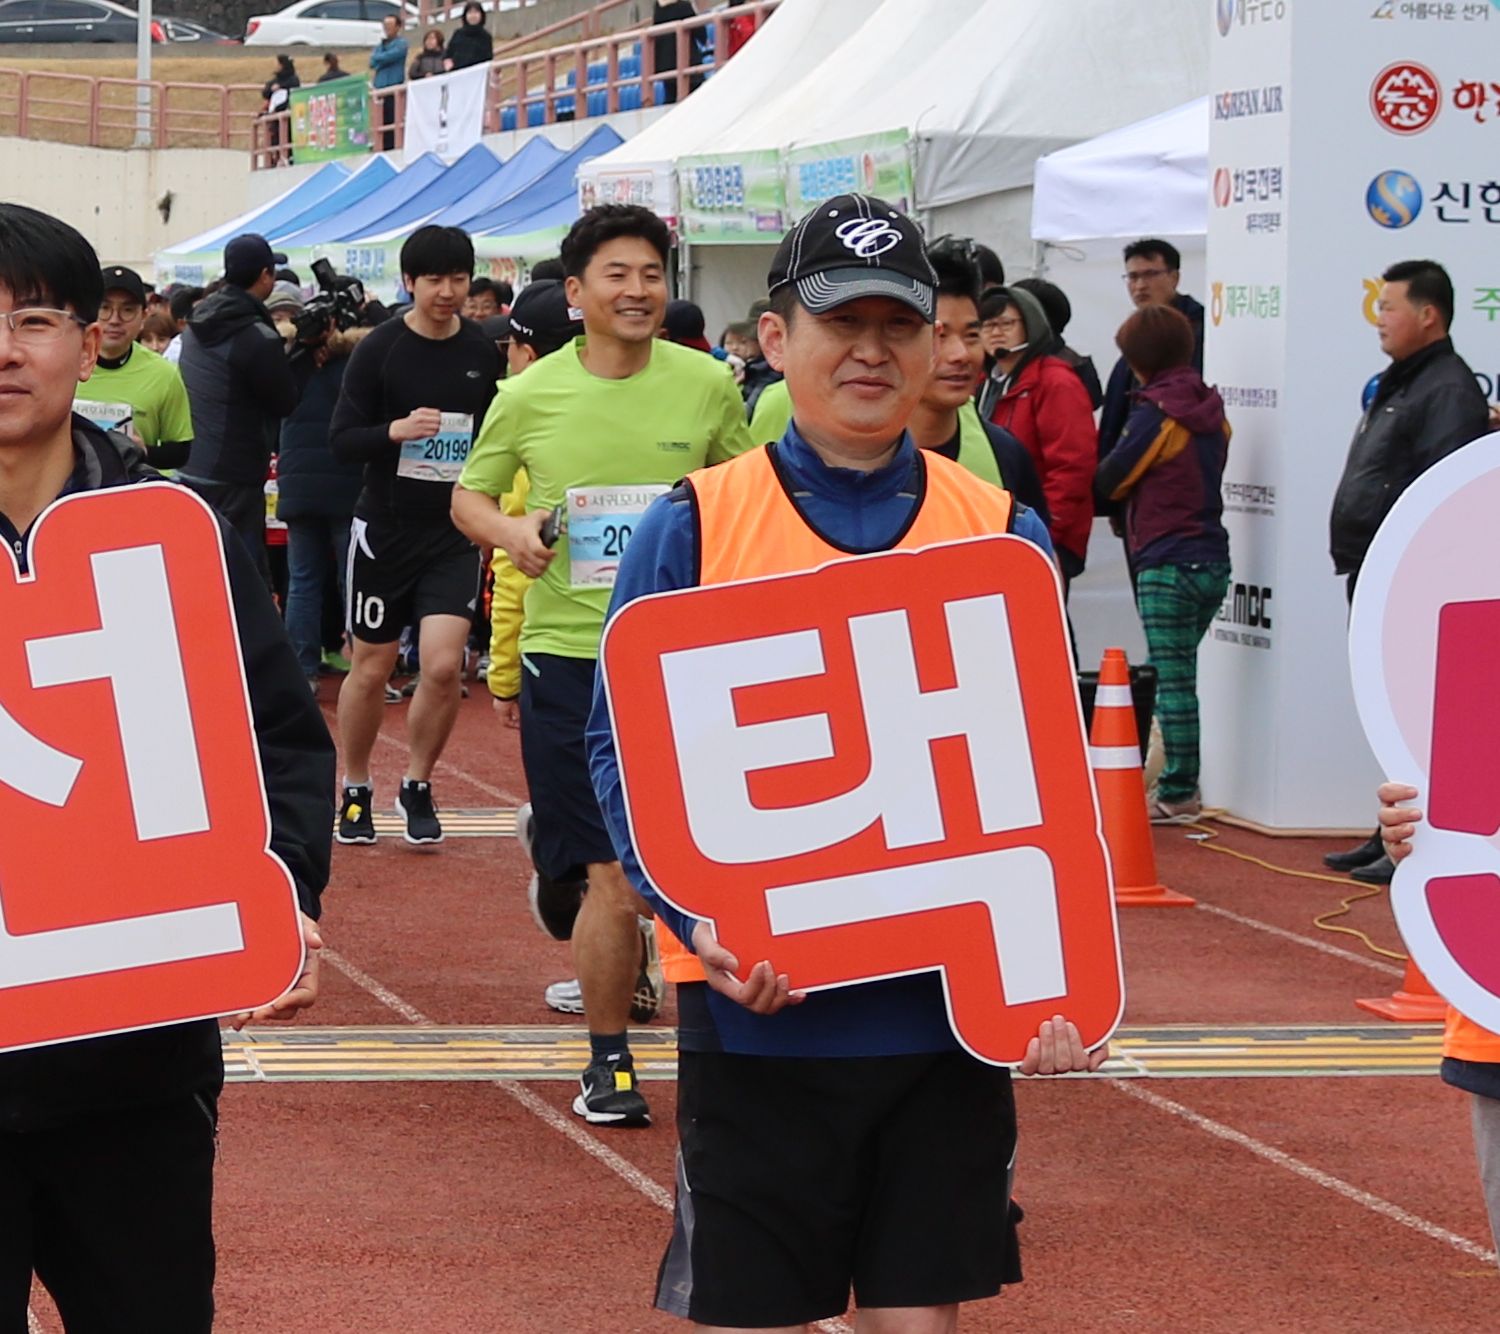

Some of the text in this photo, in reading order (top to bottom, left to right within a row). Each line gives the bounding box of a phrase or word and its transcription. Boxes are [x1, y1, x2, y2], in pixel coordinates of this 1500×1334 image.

[1399, 1, 1491, 22] 아름다운 선거
[1214, 84, 1283, 121] KOREAN AIR
[1232, 166, 1283, 203] 한국전력
[423, 438, 469, 460] 20199
[355, 590, 385, 630] 10
[660, 593, 1069, 1005] 택
